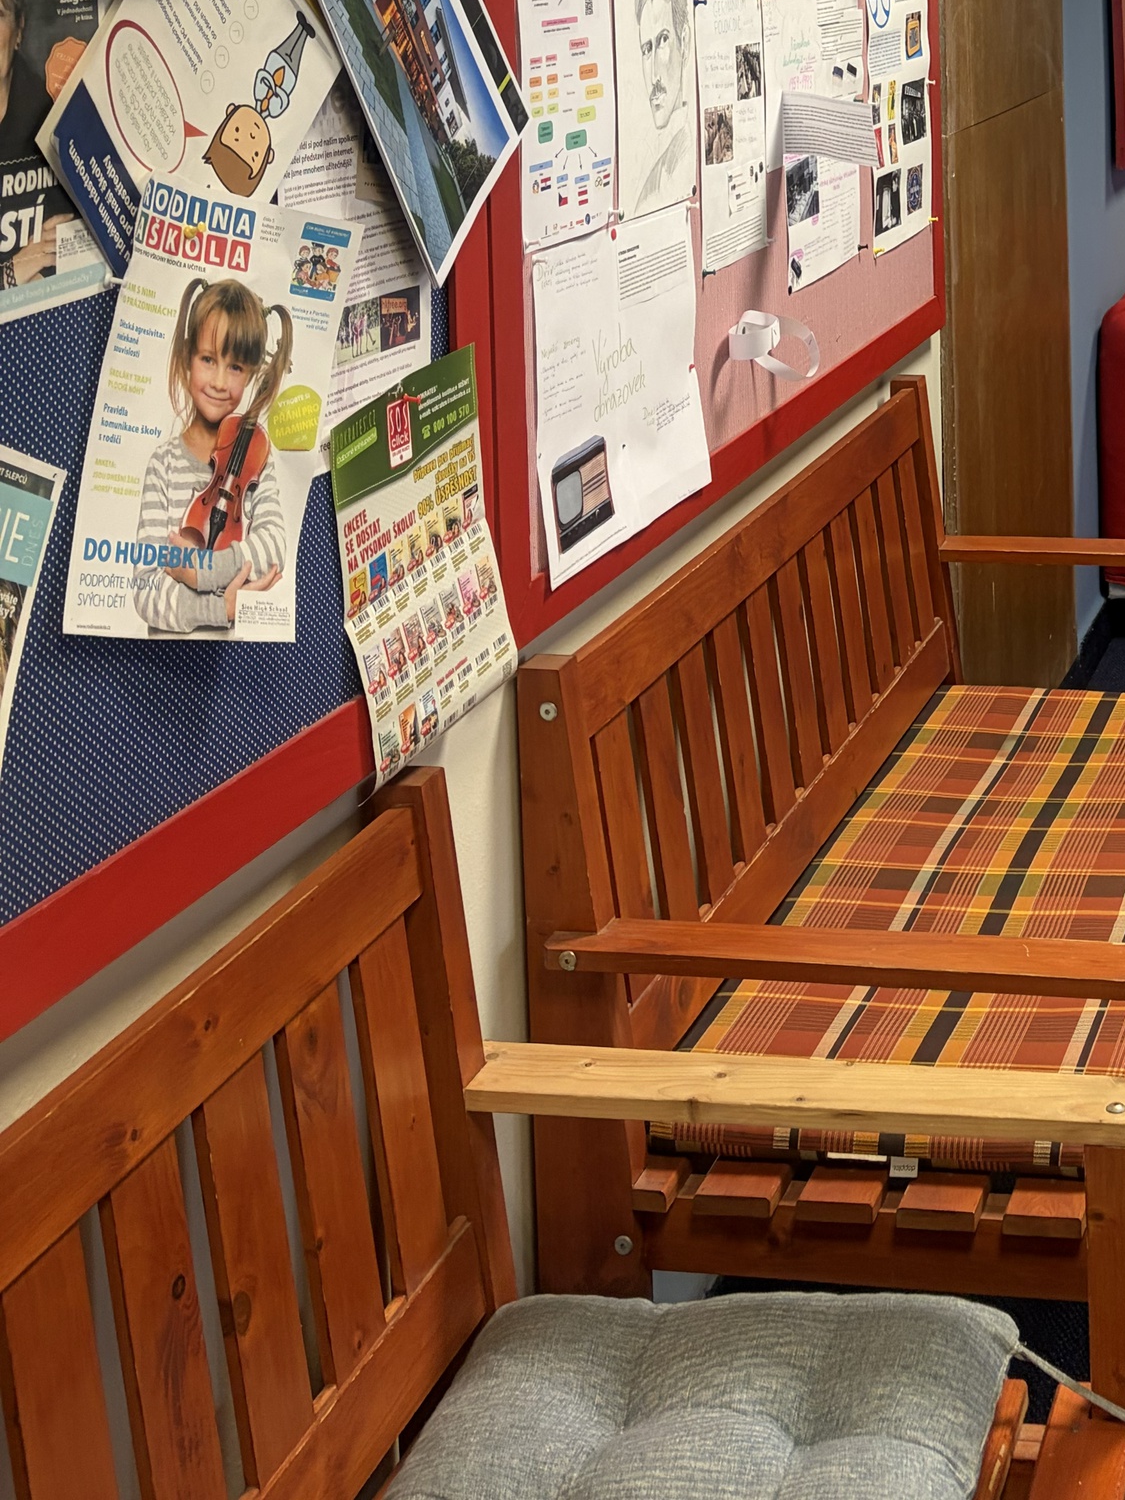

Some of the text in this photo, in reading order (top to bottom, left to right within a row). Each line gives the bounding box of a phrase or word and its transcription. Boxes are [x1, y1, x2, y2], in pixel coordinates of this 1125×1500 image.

[171, 11, 183, 28] nebo
[180, 28, 188, 39] PC
[86, 156, 109, 191] školu
[101, 154, 140, 217] prostředky
[63, 138, 128, 254] ideálním nástrojem,
[102, 189, 123, 215] naši
[142, 179, 251, 238] RODINA
[166, 257, 182, 268] RODIČE
[187, 263, 206, 273] UČITELE
[591, 322, 637, 396] Výroba
[593, 361, 647, 424] obrazovek
[103, 403, 128, 416] Pravidla
[389, 403, 409, 436] SOS
[101, 417, 162, 438] komunikace školy
[102, 433, 121, 444] rodiči
[391, 431, 409, 448] click
[4, 467, 28, 485] SLEPCŮ
[413, 458, 437, 483] Příprava
[437, 453, 449, 468] pro
[417, 465, 478, 518] 90% ÚSPĚŠNOST
[343, 509, 368, 539] CHCETE
[345, 518, 381, 557] SE DOSTAT
[21, 518, 43, 568] DNES
[83, 537, 213, 571] DO HUDEBKY!
[348, 555, 360, 574] NA
[360, 531, 392, 564] VYSOKOU
[79, 572, 162, 591] PODPOŘTE NADÁNÍ
[77, 591, 126, 609] SVÝCH DĚTÍ
